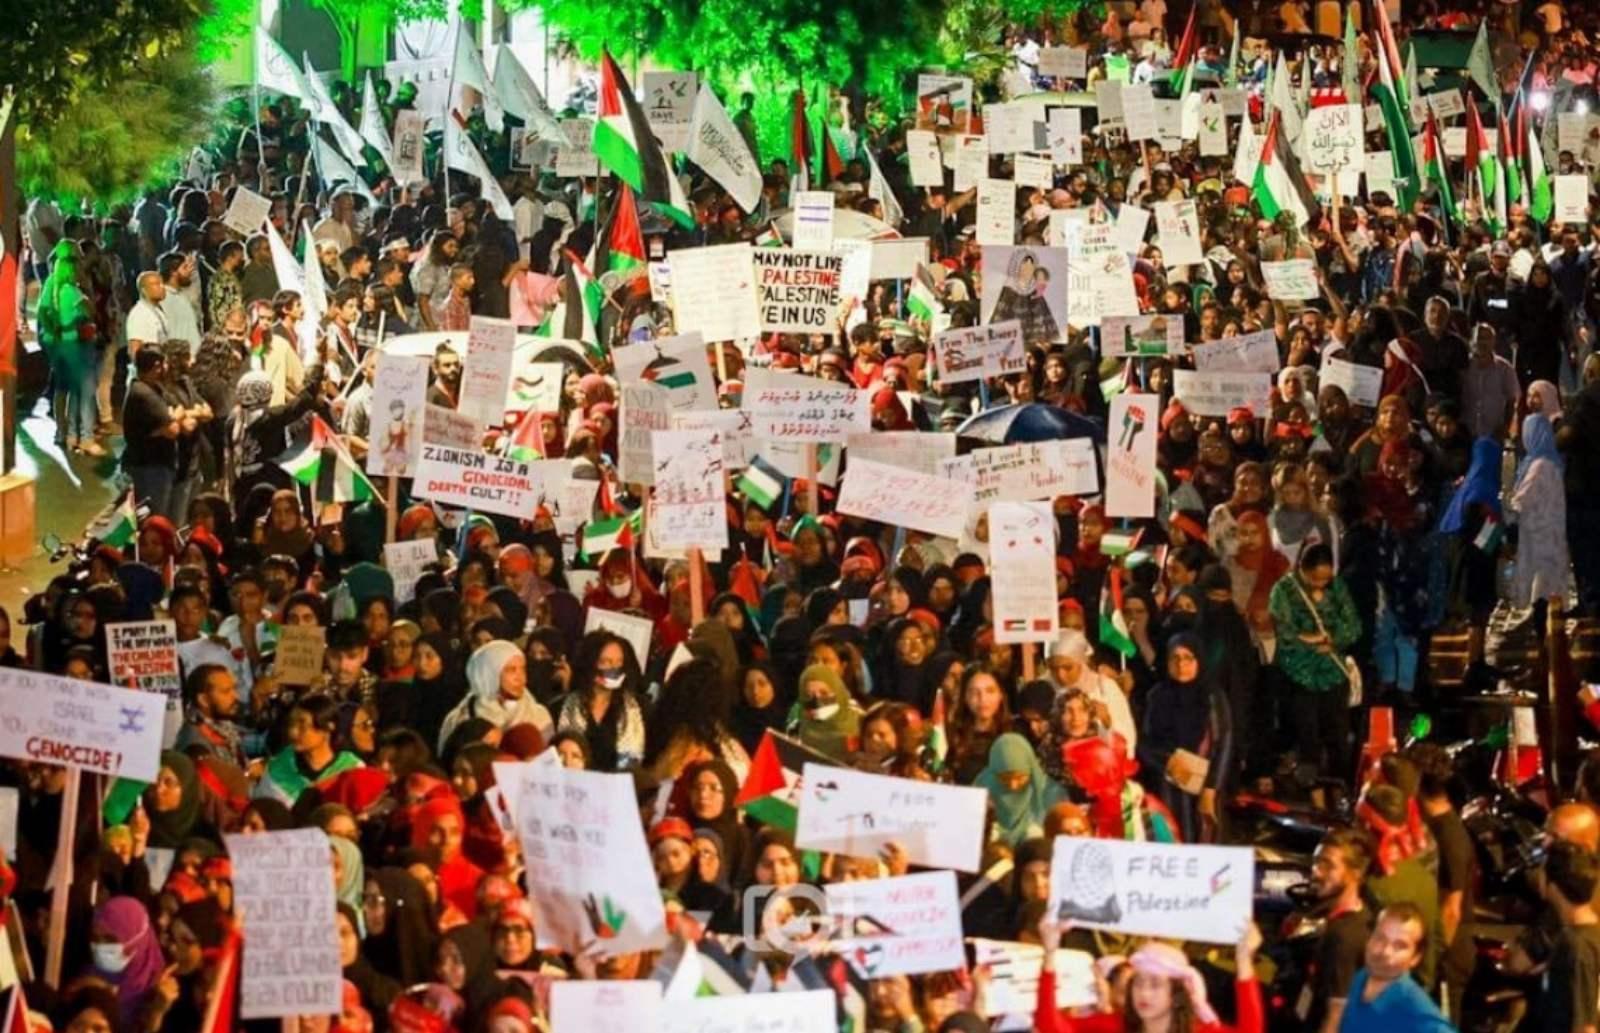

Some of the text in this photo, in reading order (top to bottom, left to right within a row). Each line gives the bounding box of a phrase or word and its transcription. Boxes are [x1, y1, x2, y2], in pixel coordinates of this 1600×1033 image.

[752, 252, 843, 272] MAY NOT LIVE
[763, 268, 840, 288] PALESTINE
[782, 306, 799, 323] IN
[803, 307, 827, 326] US
[423, 447, 529, 476] ZIONISM IS A
[428, 480, 467, 495] DEATH
[470, 486, 505, 500] CULT
[112, 624, 167, 639] I PRAY FOR
[113, 639, 132, 650] THE
[112, 648, 175, 662] THE CHILDREN
[130, 662, 174, 676] ALESTINE
[53, 701, 97, 724] ISRAEL
[1126, 855, 1200, 879] FREE
[1126, 891, 1211, 914] Palestine
